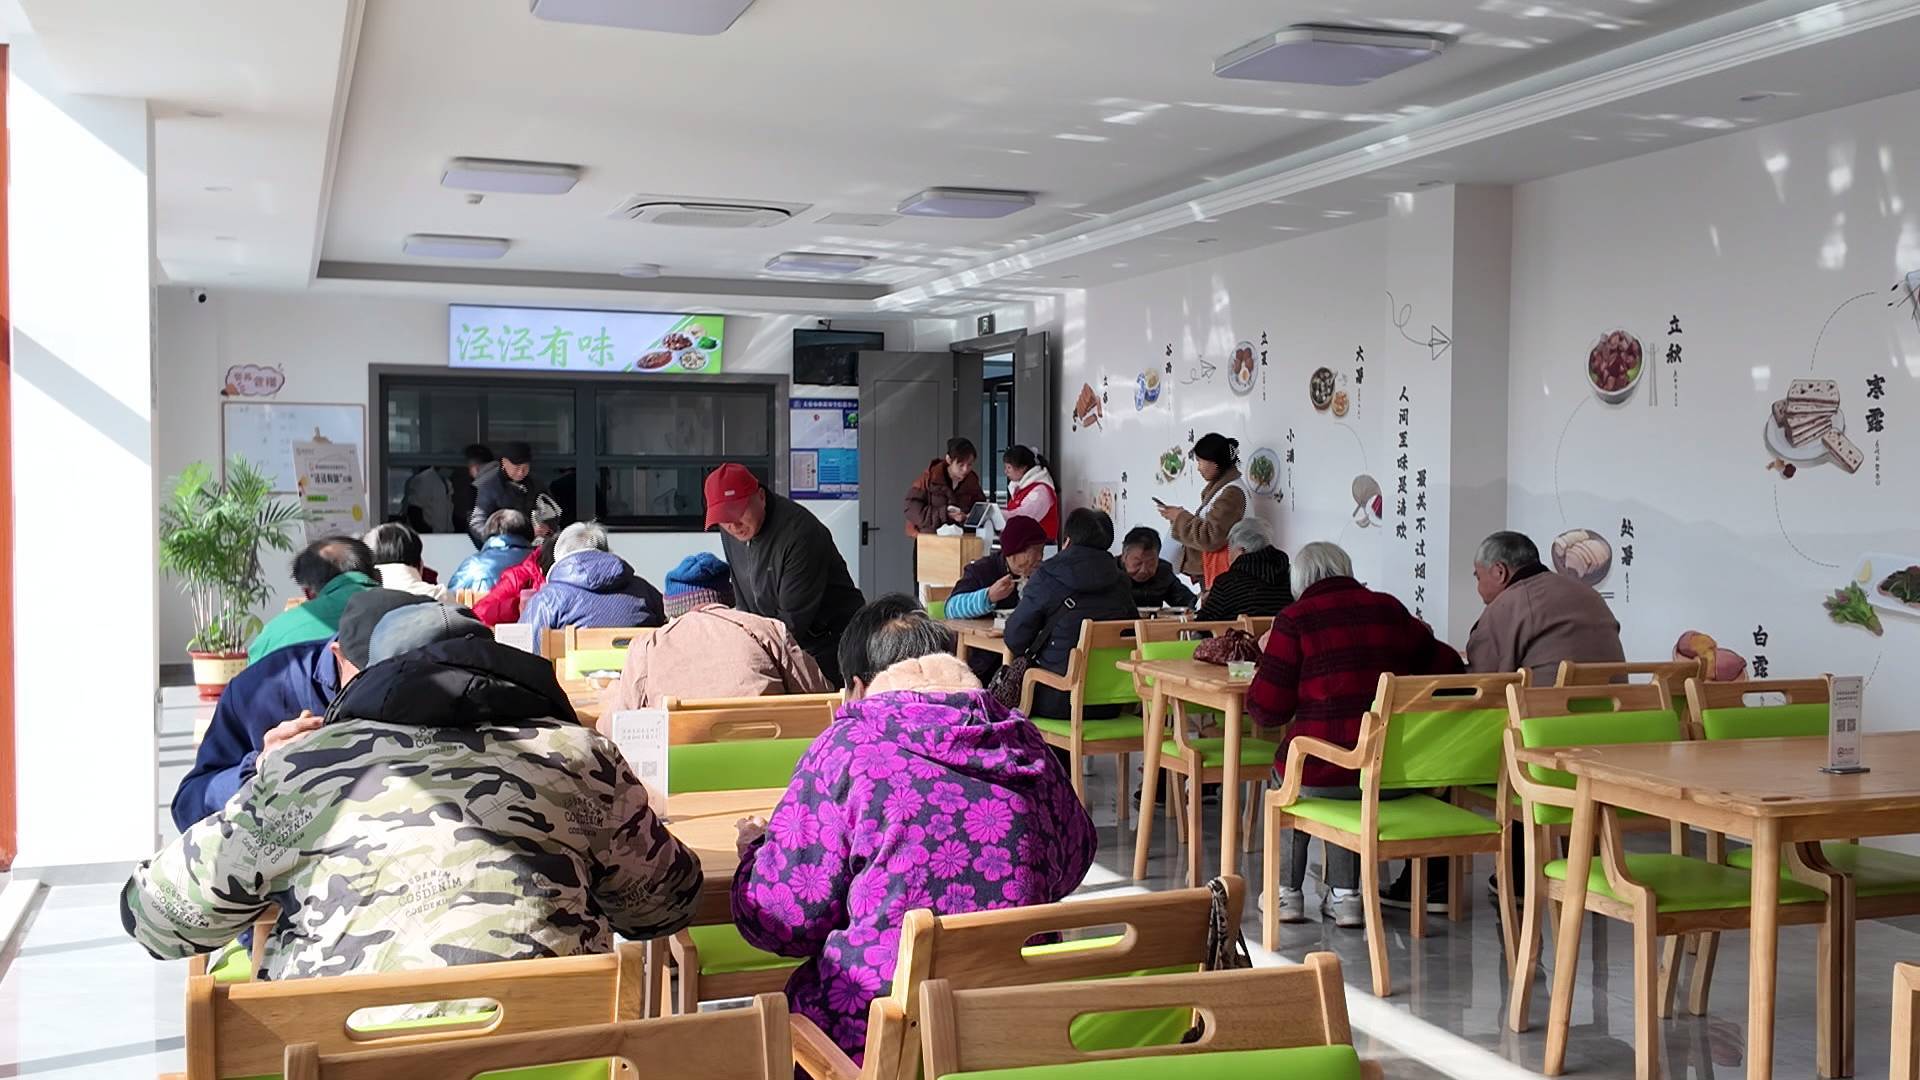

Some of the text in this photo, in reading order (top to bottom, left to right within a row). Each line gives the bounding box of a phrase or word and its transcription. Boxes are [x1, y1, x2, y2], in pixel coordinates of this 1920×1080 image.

[457, 323, 615, 367] 泾泾有味
[1261, 331, 1268, 366] 立夏
[1666, 314, 1682, 363] 立秋
[1356, 345, 1364, 384] 大暑
[1865, 374, 1885, 432] 寒露
[1396, 386, 1409, 540] 人间至味是清欢
[1621, 518, 1634, 566] 处暑
[1752, 625, 1768, 678] 白露
[398, 876, 463, 907] COSDENIM
